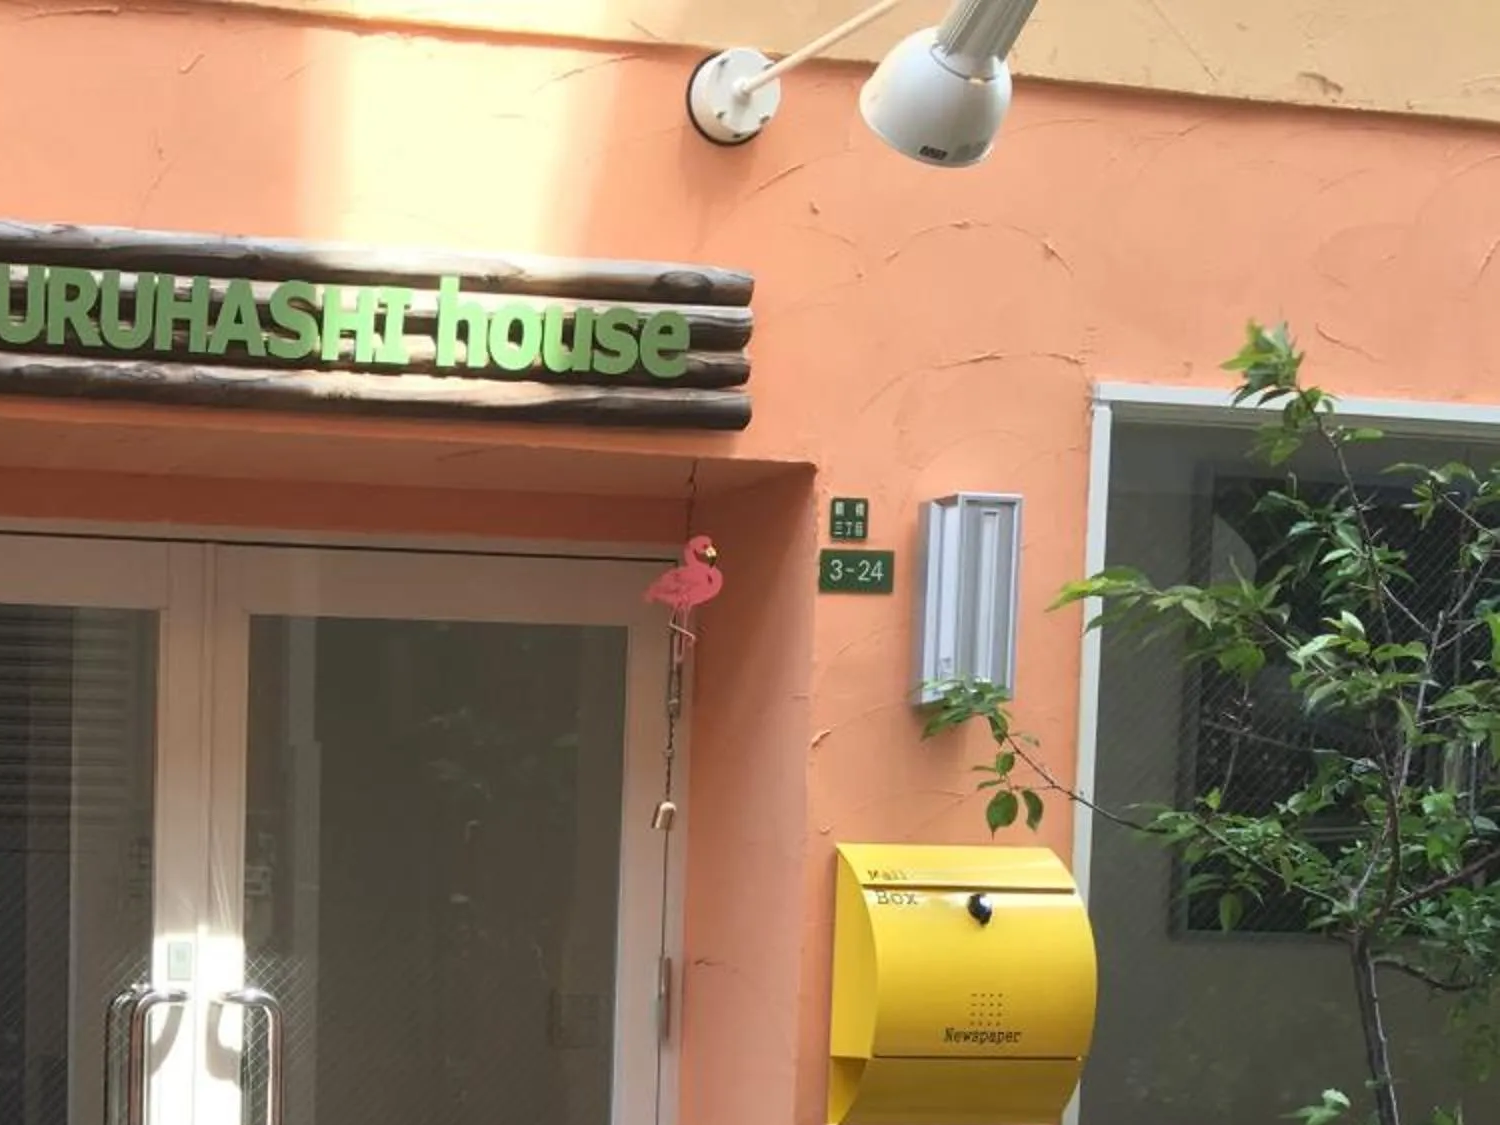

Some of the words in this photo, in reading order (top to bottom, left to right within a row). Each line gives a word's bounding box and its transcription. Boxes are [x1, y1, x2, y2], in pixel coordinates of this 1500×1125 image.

[435, 275, 692, 379] house
[829, 559, 884, 581] 3-24
[874, 889, 918, 905] Box
[943, 1026, 1022, 1046] Newspaper
